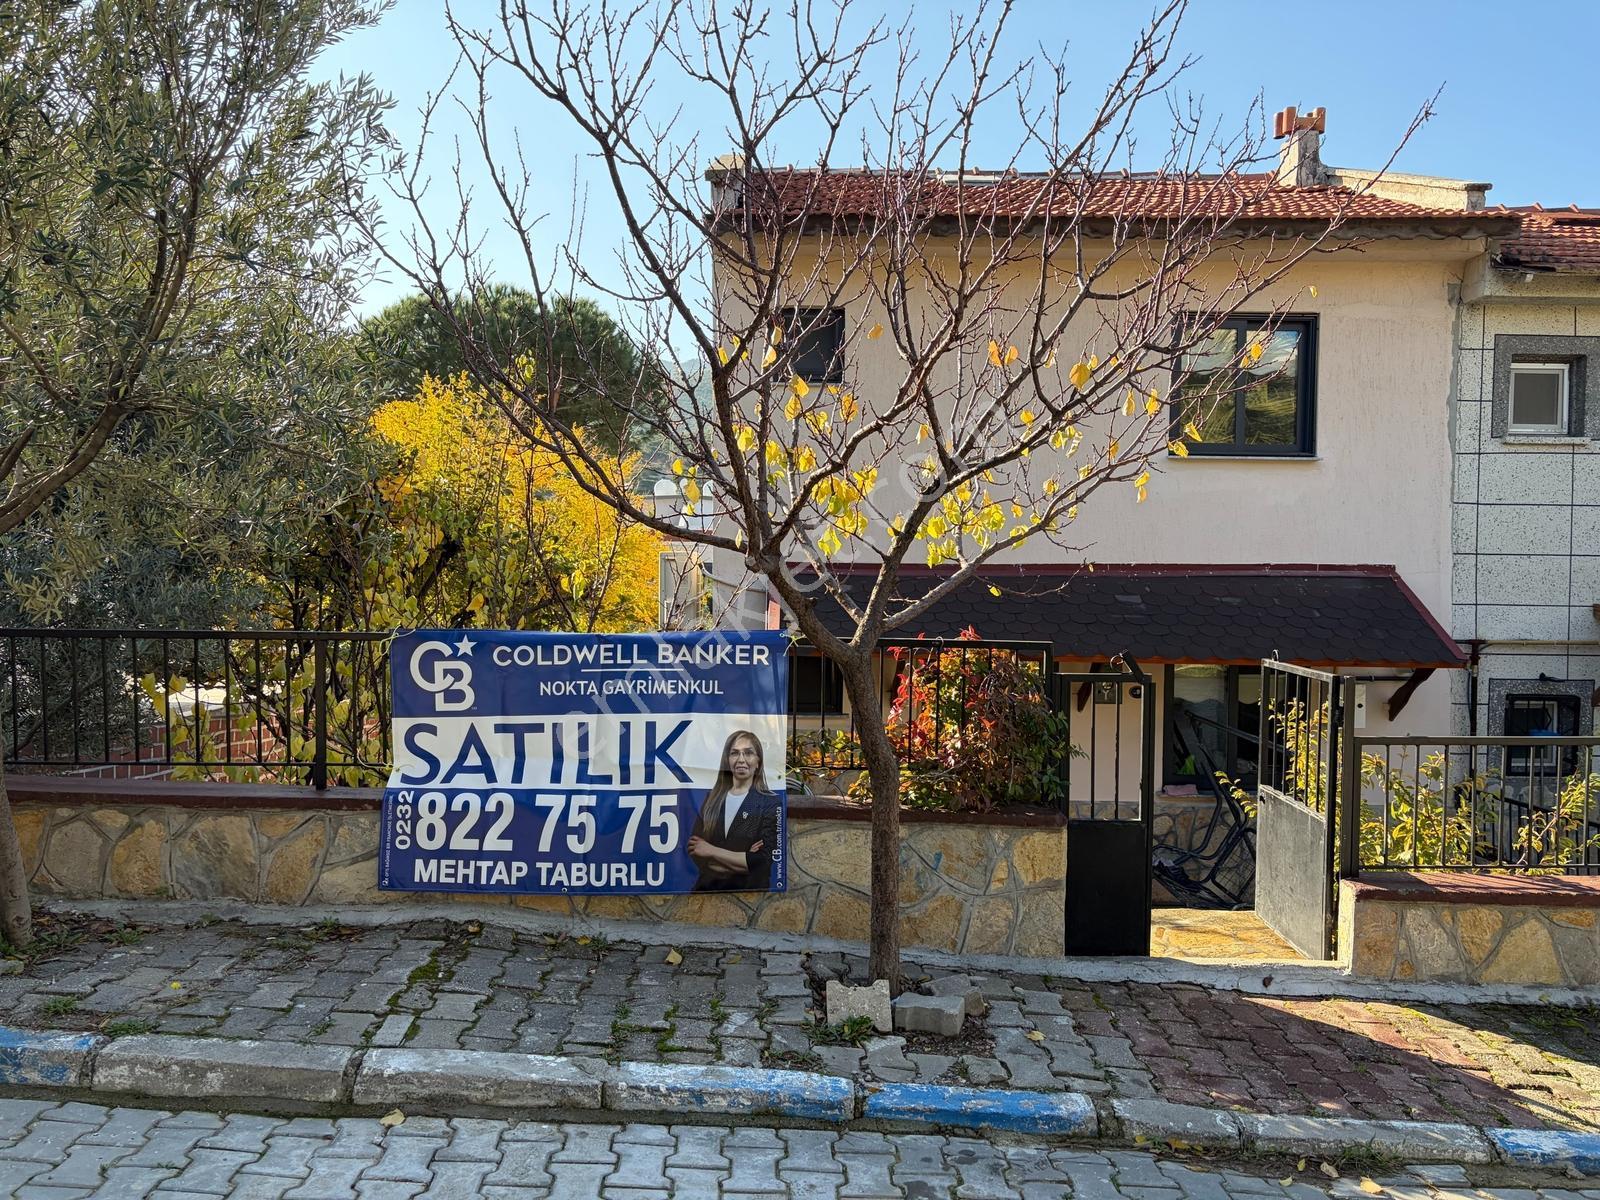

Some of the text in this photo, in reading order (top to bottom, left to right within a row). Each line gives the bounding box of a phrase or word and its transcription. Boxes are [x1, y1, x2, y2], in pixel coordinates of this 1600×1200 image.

[492, 643, 770, 667] COLDWELL BANKER
[539, 676, 724, 696] NOKTA GAYRİMENKUL
[399, 719, 694, 786] SATILIK
[395, 790, 414, 851] 0232
[415, 791, 680, 854] 822 75 75
[414, 858, 665, 887] MEHTAP TABURLU
